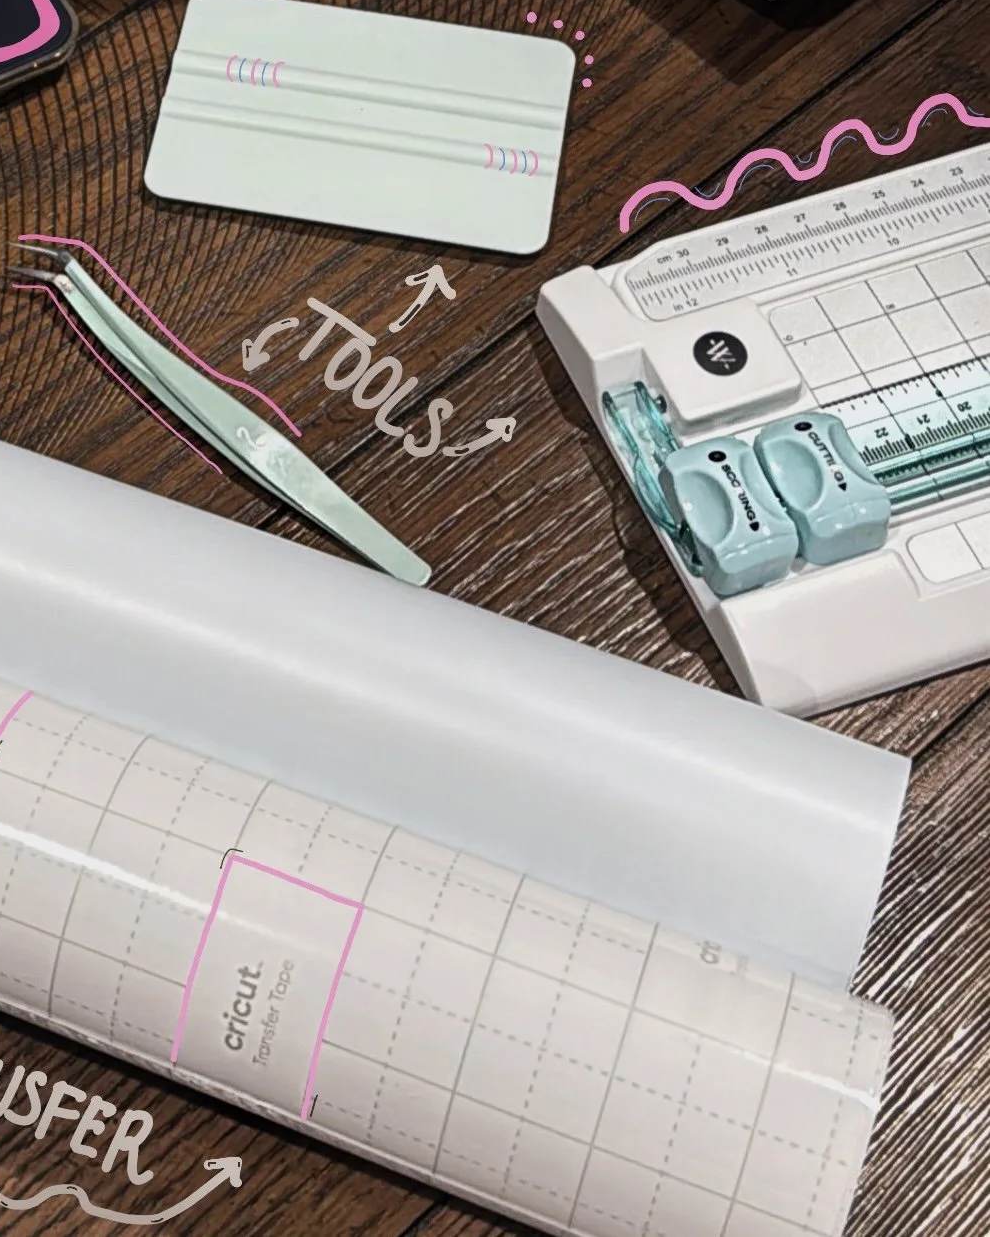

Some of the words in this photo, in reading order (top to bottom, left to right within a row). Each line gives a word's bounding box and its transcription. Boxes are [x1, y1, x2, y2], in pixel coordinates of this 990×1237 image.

[656, 255, 673, 265] cm
[675, 248, 691, 259] 30
[716, 237, 730, 247] 29
[754, 224, 769, 235] 28
[794, 213, 806, 223] 27
[833, 201, 847, 211] 26
[871, 188, 886, 200] 25
[911, 178, 925, 188] 24
[949, 166, 964, 177] 23
[673, 303, 685, 312] in
[686, 298, 699, 307] 12
[887, 237, 900, 246] 10
[808, 431, 844, 482] CUTTIG
[224, 960, 264, 1052] cricut
[252, 1002, 280, 1067] Transfer
[268, 958, 295, 1002] Tape
